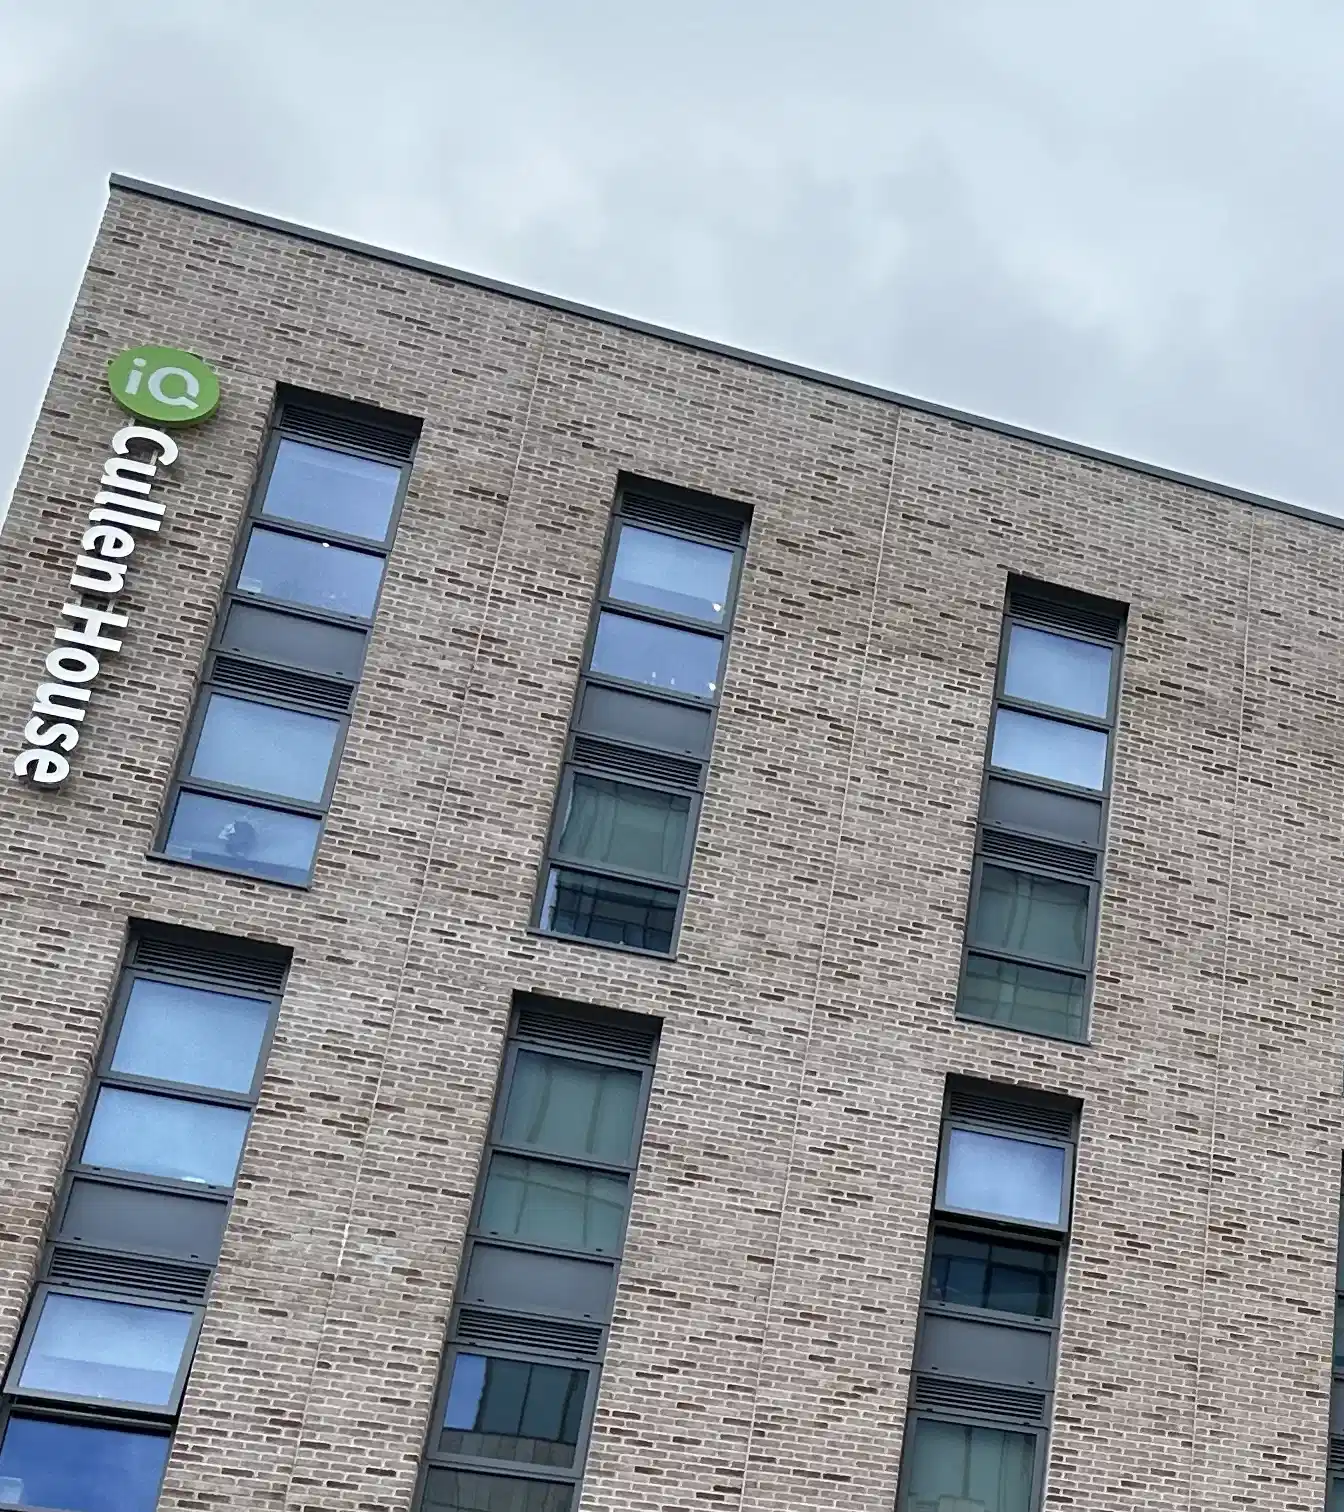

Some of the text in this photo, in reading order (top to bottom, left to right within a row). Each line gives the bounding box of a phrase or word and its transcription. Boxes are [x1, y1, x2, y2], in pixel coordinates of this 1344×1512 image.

[125, 358, 199, 409] iQ
[14, 426, 178, 784] Cullen House
